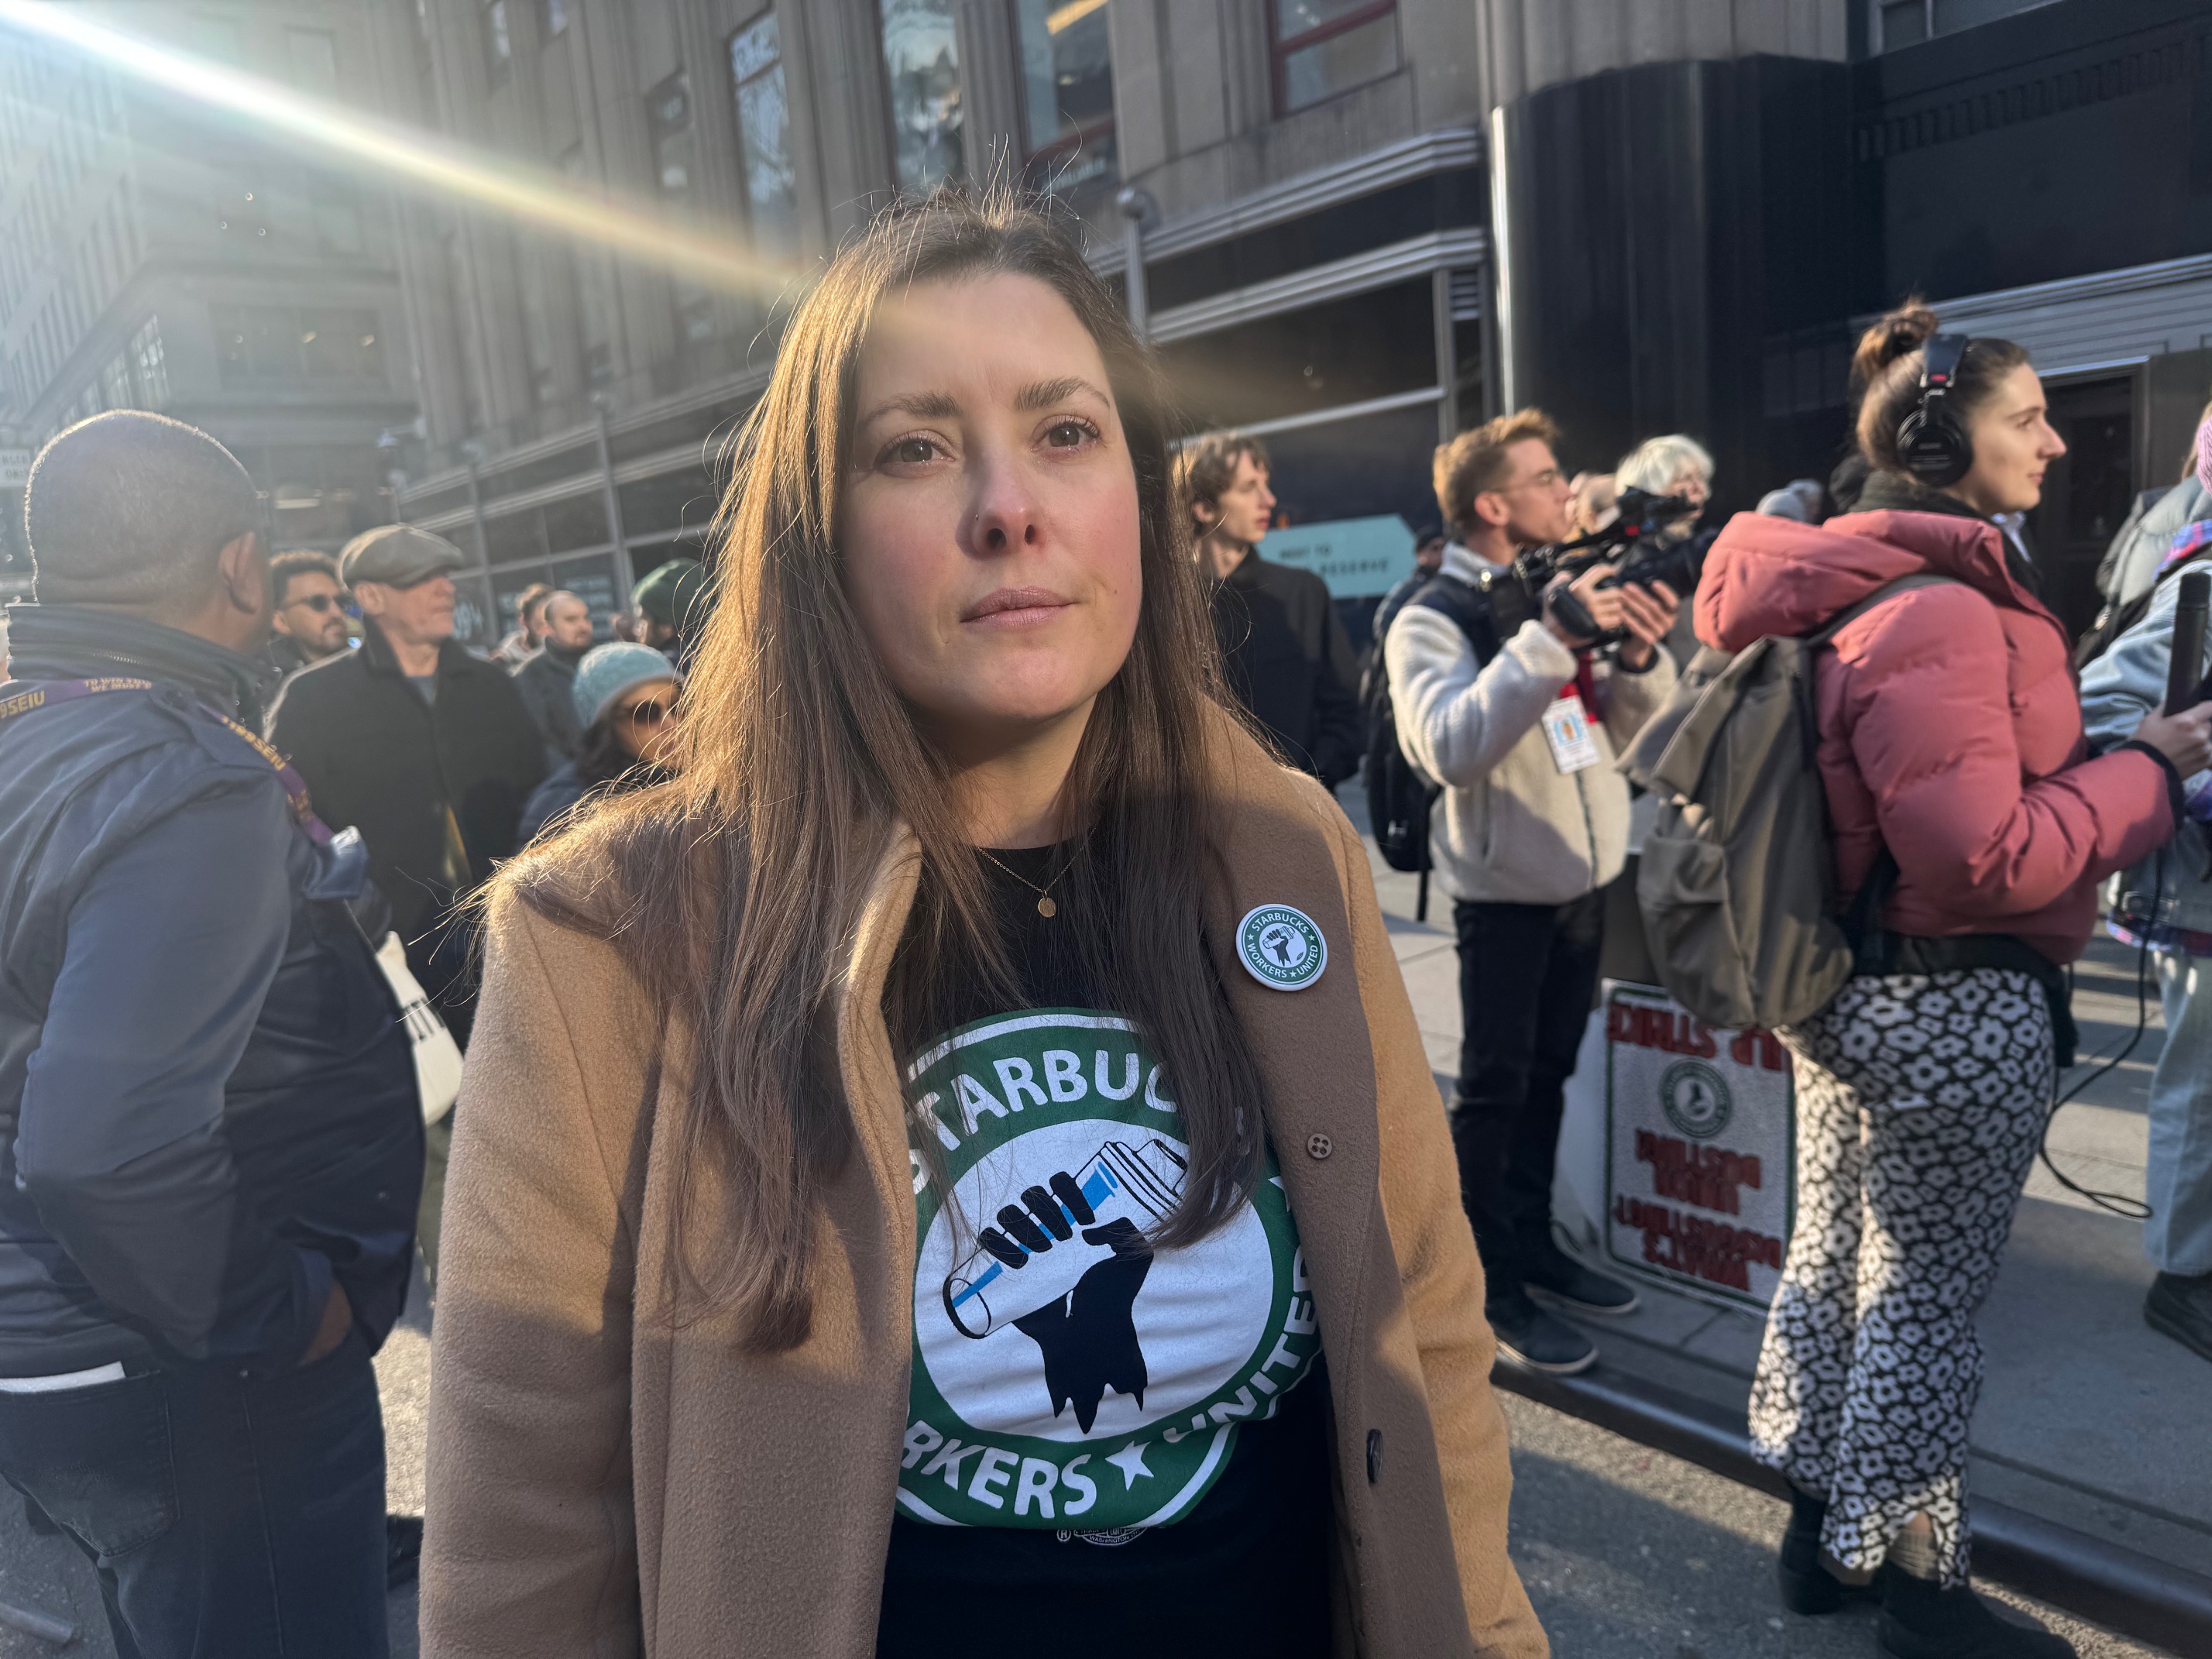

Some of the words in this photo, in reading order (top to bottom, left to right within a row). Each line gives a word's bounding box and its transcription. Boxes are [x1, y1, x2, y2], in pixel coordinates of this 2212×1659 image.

[1252, 912, 1310, 934] STARBUCKS
[1247, 943, 1287, 978] WORKERS
[1296, 945, 1318, 976] UNITED
[909, 1049, 1178, 1195] TARBUC
[900, 1420, 1097, 1520] RKERS
